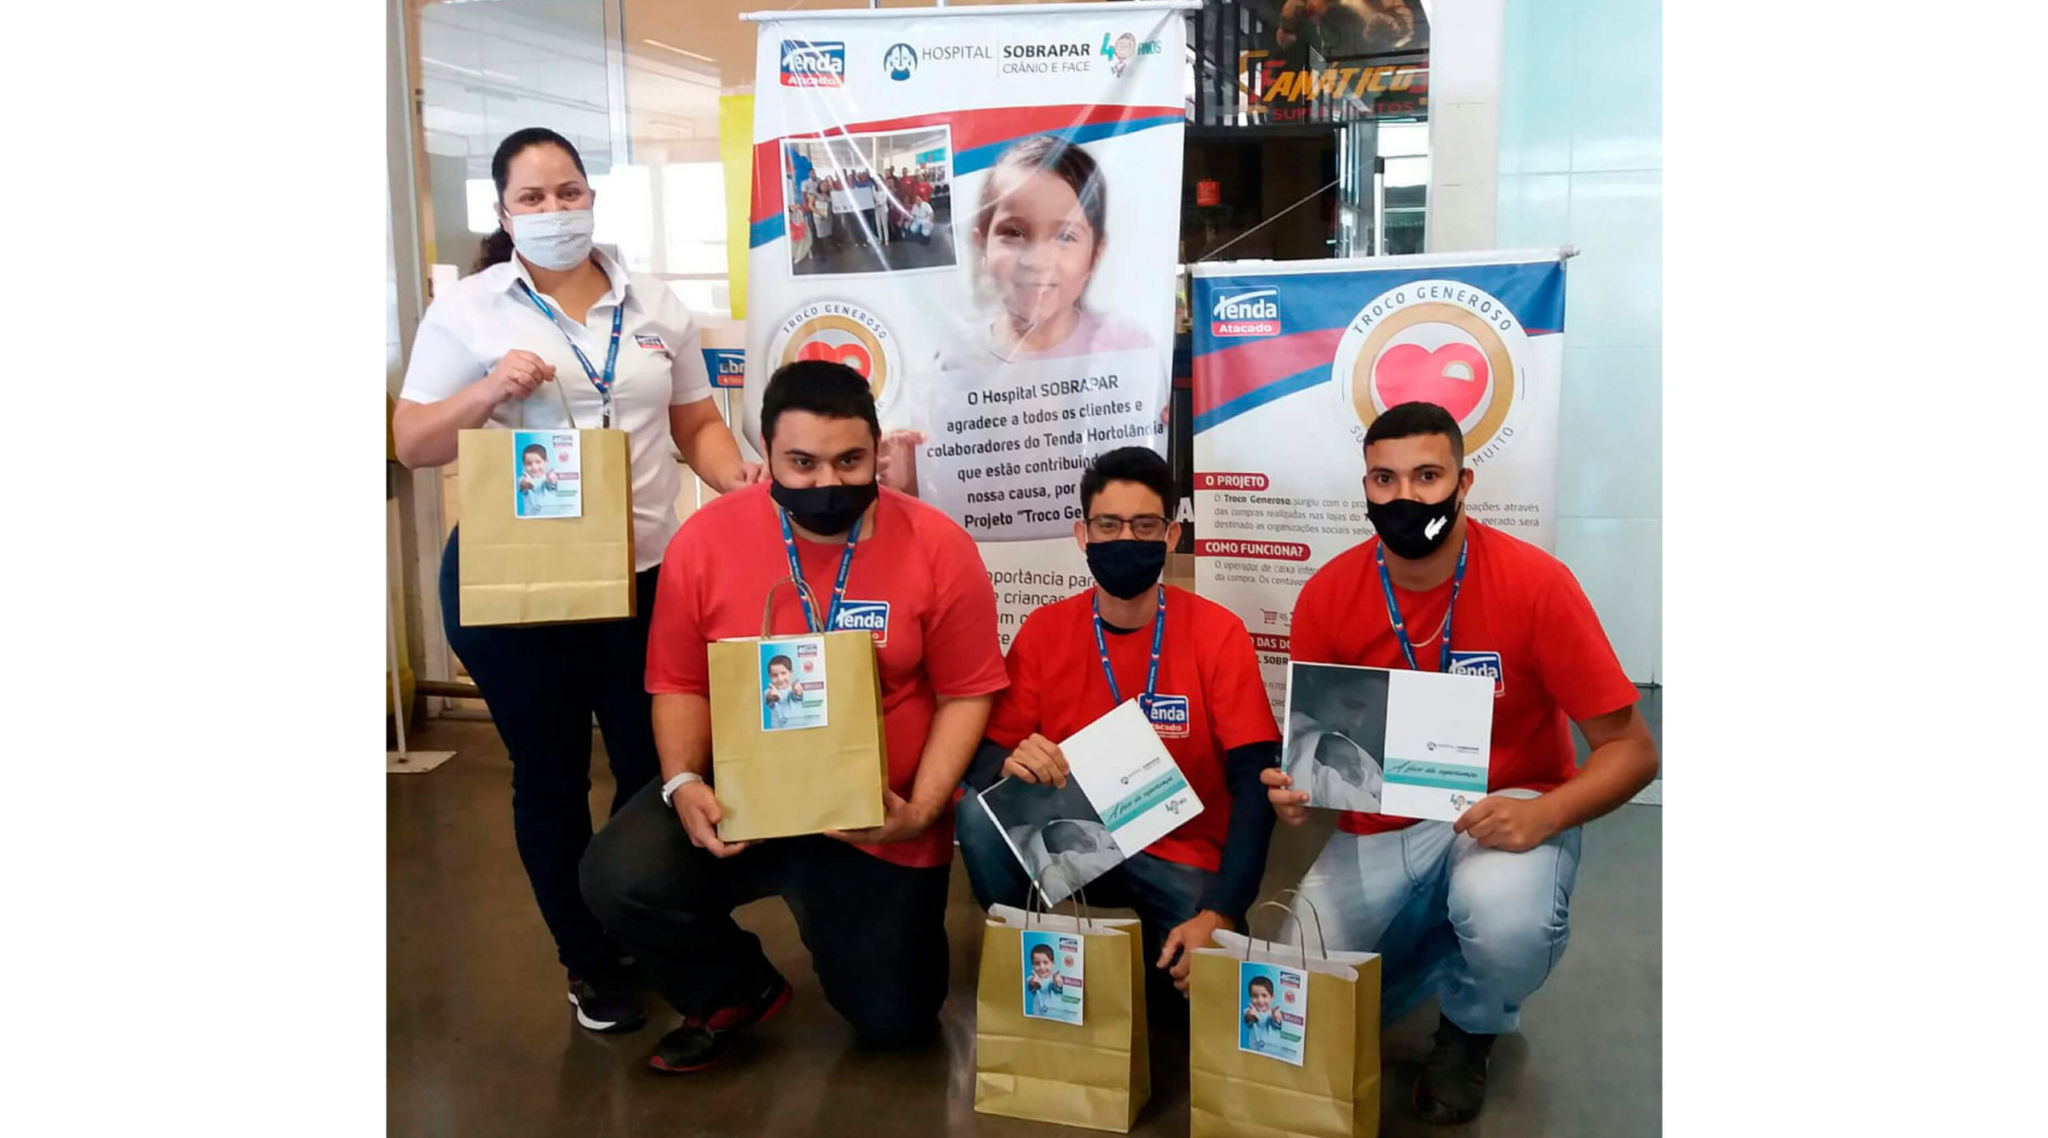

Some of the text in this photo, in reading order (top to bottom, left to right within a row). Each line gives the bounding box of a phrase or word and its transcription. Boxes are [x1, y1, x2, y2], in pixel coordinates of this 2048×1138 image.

[782, 45, 843, 72] Tenda
[922, 43, 1090, 61] HOSPITAL SOBRAPAR
[1002, 61, 1090, 74] CRÂNIO E FACE
[1213, 290, 1277, 320] Tenda
[1353, 286, 1512, 334] TROCO GENEROSO
[783, 304, 887, 339] TROCO GENEROSO
[1219, 323, 1273, 333] Atacado
[968, 375, 1118, 406] O Hospital SOBRAPAR
[947, 400, 1143, 434] agradece a todos os clientes e
[927, 438, 1020, 457] colaboradores
[1024, 436, 1040, 449] do
[1043, 429, 1083, 447] Tenda
[1472, 426, 1514, 467] MUITO
[957, 453, 1099, 482] que estão contribuind
[1205, 475, 1265, 488] O PROJETO
[967, 484, 1076, 503] nossa causa, por
[1224, 494, 1247, 503] Troco
[1250, 495, 1291, 505] Generoso
[1322, 499, 1339, 507] com
[1466, 502, 1500, 512] oações
[1504, 503, 1540, 512] através
[964, 511, 1013, 529] Projeto
[1214, 507, 1228, 516] das
[1231, 509, 1264, 519] compras
[1266, 508, 1306, 519] realizadas
[1309, 512, 1324, 520] nas
[1326, 510, 1346, 522] lojas
[1350, 511, 1361, 521] do
[1214, 520, 1254, 529] destinado
[1267, 522, 1319, 534] organizações
[1321, 524, 1350, 534] sociais
[1205, 542, 1304, 557] COMO FUNCIONA?
[1214, 560, 1221, 568] O
[1261, 563, 1272, 572] de
[1259, 575, 1270, 583] Os
[1271, 577, 1306, 586] centavo
[836, 606, 886, 628] Tenda
[1257, 638, 1277, 649] DAS
[1448, 657, 1498, 678] Tenda
[1151, 702, 1185, 721] enda
